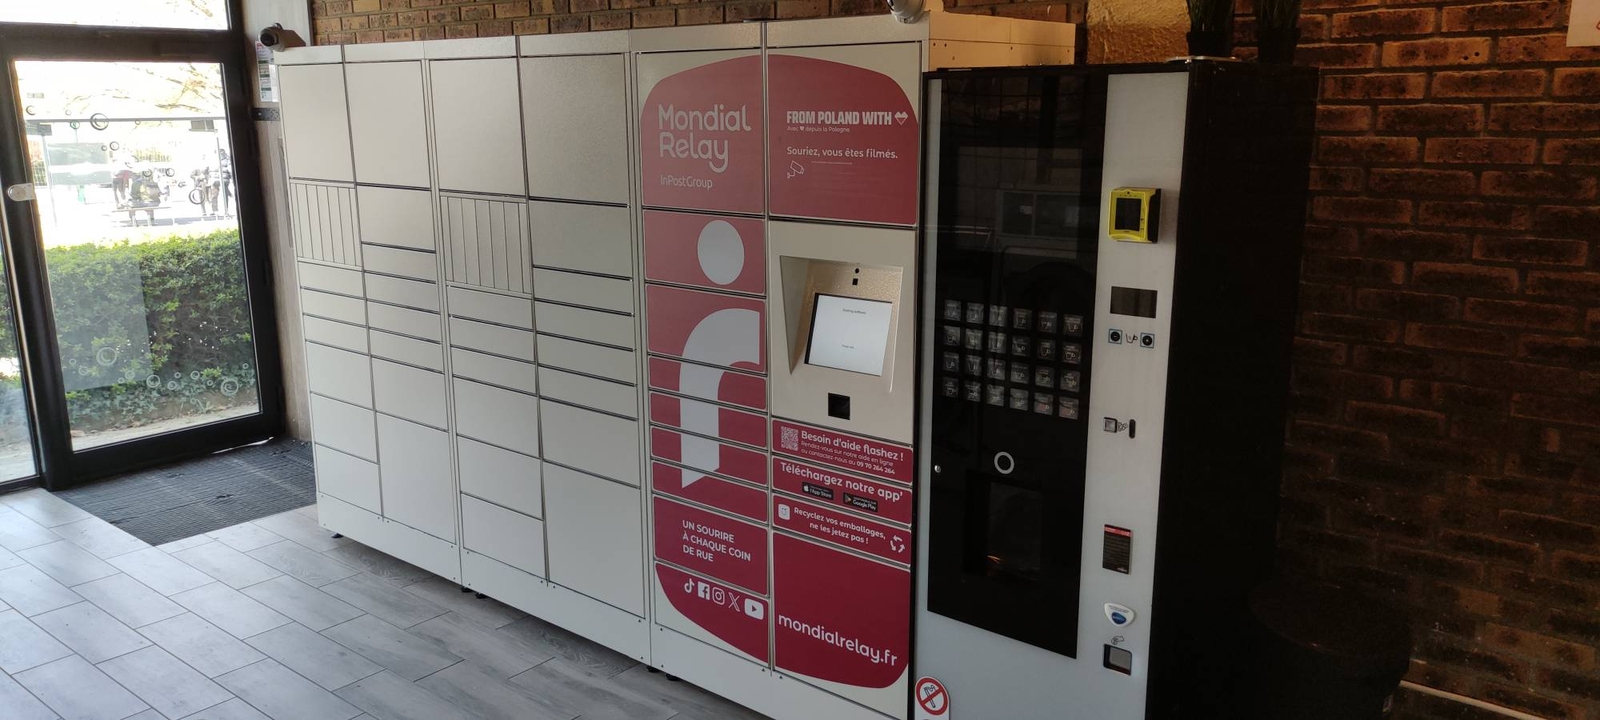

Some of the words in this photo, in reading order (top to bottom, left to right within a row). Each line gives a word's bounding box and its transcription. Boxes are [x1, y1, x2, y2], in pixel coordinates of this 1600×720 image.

[658, 104, 752, 131] Mondial
[786, 110, 816, 124] FROM
[818, 111, 859, 125] POLAND
[862, 112, 892, 126] WITH
[660, 132, 728, 173] Relay
[786, 146, 820, 157] Souriez,
[822, 149, 842, 157] vous
[845, 148, 863, 157] êtes
[866, 148, 898, 159] filmés.
[801, 431, 830, 445] Besoin
[833, 438, 861, 451] d'aide
[863, 444, 898, 460] flashez
[900, 452, 904, 461] !
[801, 440, 833, 452] Rendez-vous
[843, 450, 857, 458] notre
[880, 458, 893, 467] ligne
[809, 450, 847, 463] contactez-nous
[780, 462, 842, 486] Téléchargez
[845, 481, 874, 494] notre
[877, 488, 903, 502] app'
[853, 500, 867, 509] Google
[682, 519, 695, 530] UN
[696, 524, 734, 544] SOURIRE
[794, 507, 824, 522] Recyclez
[826, 517, 838, 525] vos
[839, 521, 886, 539] emballages,
[809, 522, 818, 530] ne
[820, 524, 830, 533] les
[831, 527, 849, 539] jetez
[850, 533, 864, 543] pas
[682, 530, 689, 541] À
[690, 534, 727, 554] CHAQUE
[728, 547, 751, 562] COIN
[683, 544, 695, 556] DE
[696, 549, 714, 562] RUE
[778, 614, 897, 666] mondialrelay.fr
